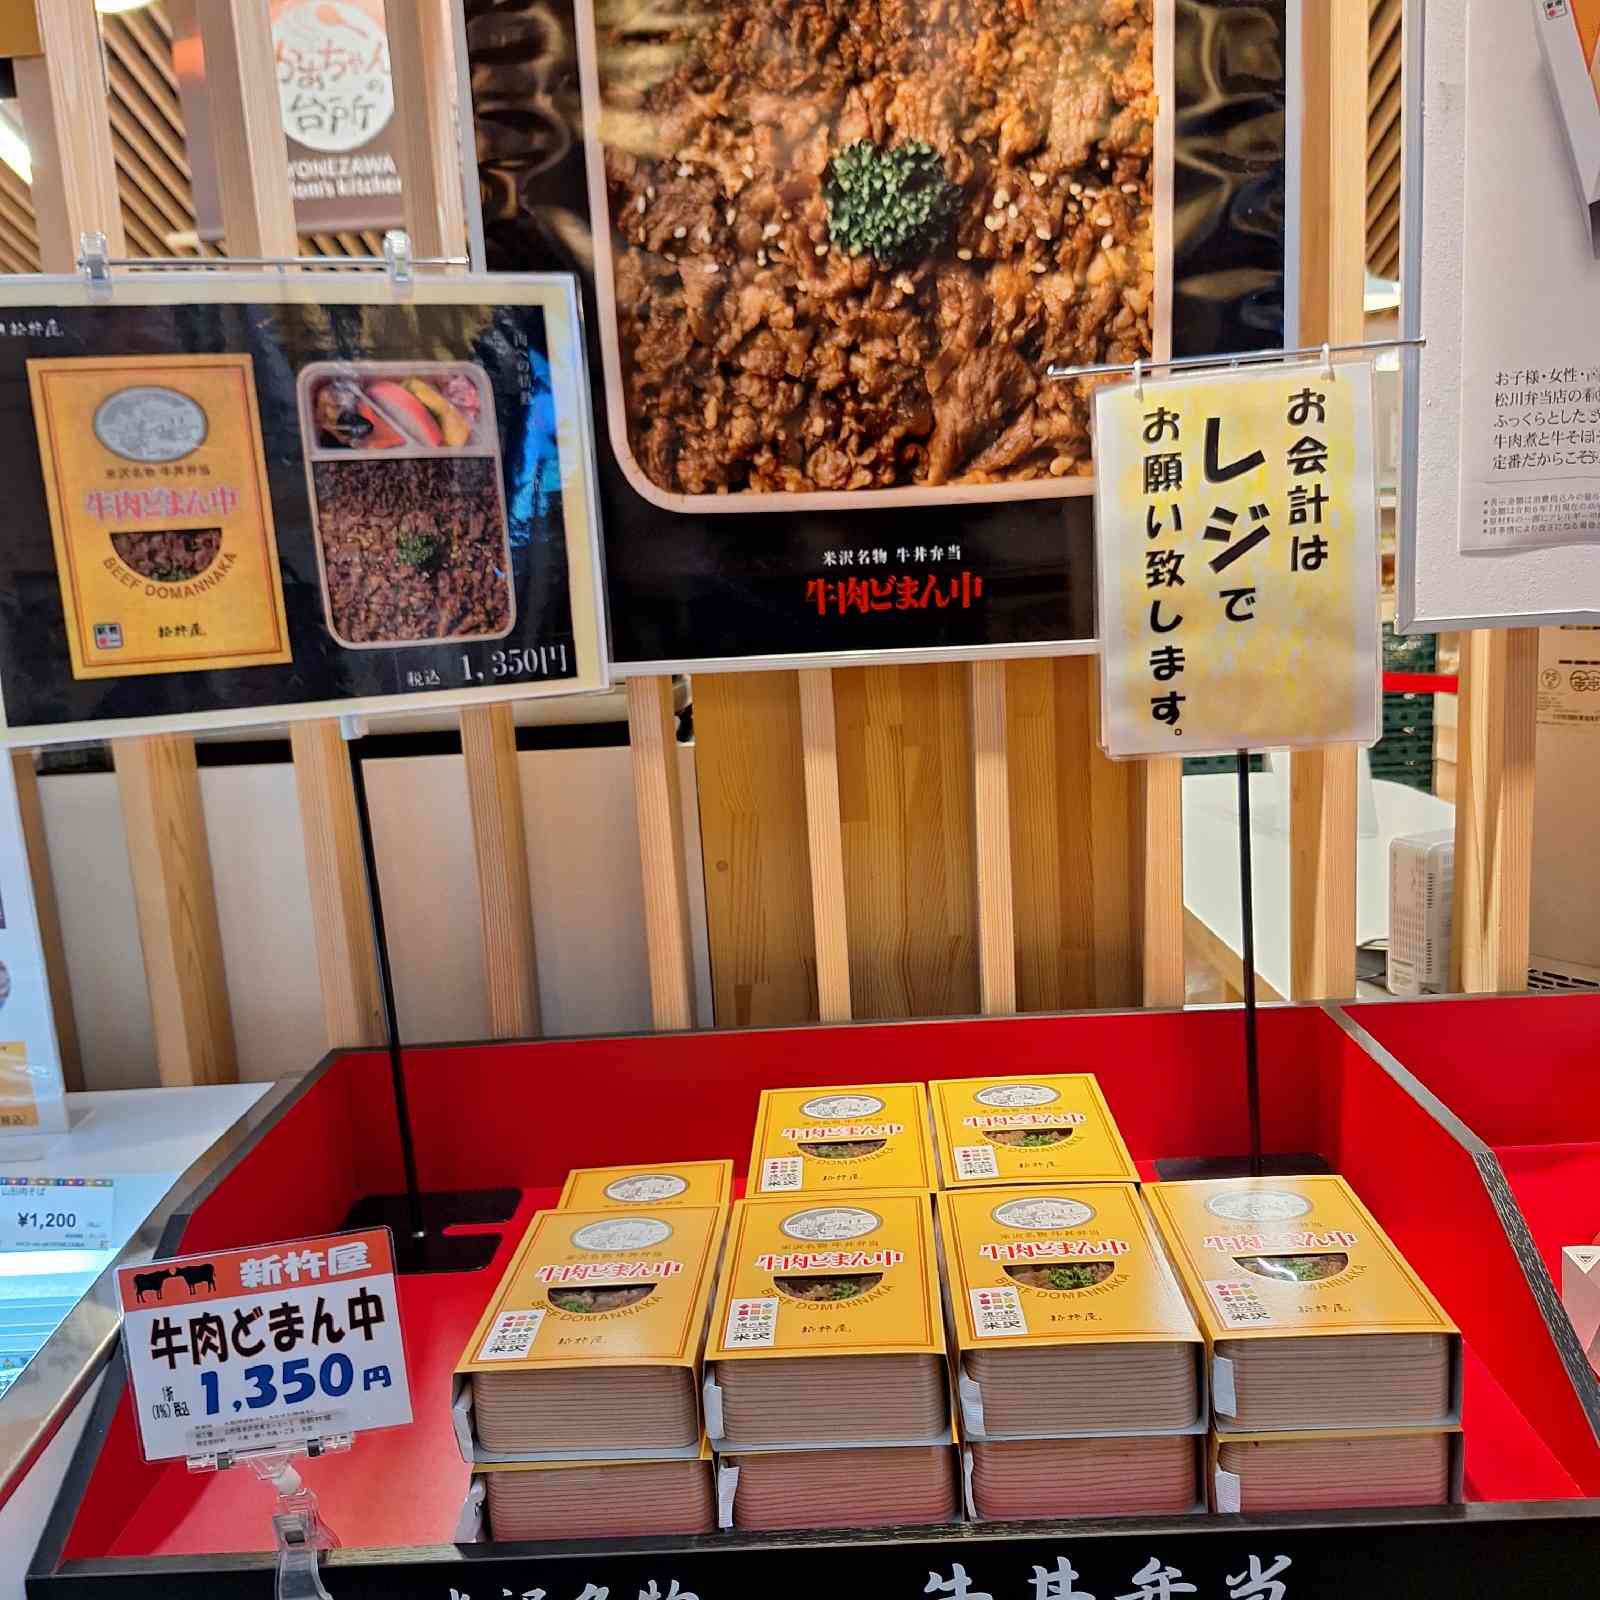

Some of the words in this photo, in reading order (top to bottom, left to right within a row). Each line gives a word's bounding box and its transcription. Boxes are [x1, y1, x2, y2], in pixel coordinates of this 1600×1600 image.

[291, 94, 376, 135] 台所
[1286, 387, 1330, 573] お会計は
[1202, 416, 1272, 622] レジで
[103, 556, 142, 592] BEEF
[145, 552, 237, 600] DOMANNAKA
[823, 549, 888, 567] 米沢名物
[896, 544, 961, 564] 牛丼弁当
[1141, 406, 1187, 738] お願い致します。
[805, 572, 984, 616] 牛肉どまん中
[406, 668, 441, 687] 税込
[17, 1211, 77, 1230] ¥1,200
[239, 1242, 372, 1288] 新杵屋
[537, 1261, 684, 1282] 牛肉どまん中
[756, 1249, 903, 1272] 牛肉どまん中
[981, 1239, 1129, 1260] 牛肉どまん中
[150, 1287, 385, 1370] 牛肉どまん中
[201, 1352, 392, 1415] 1,350円
